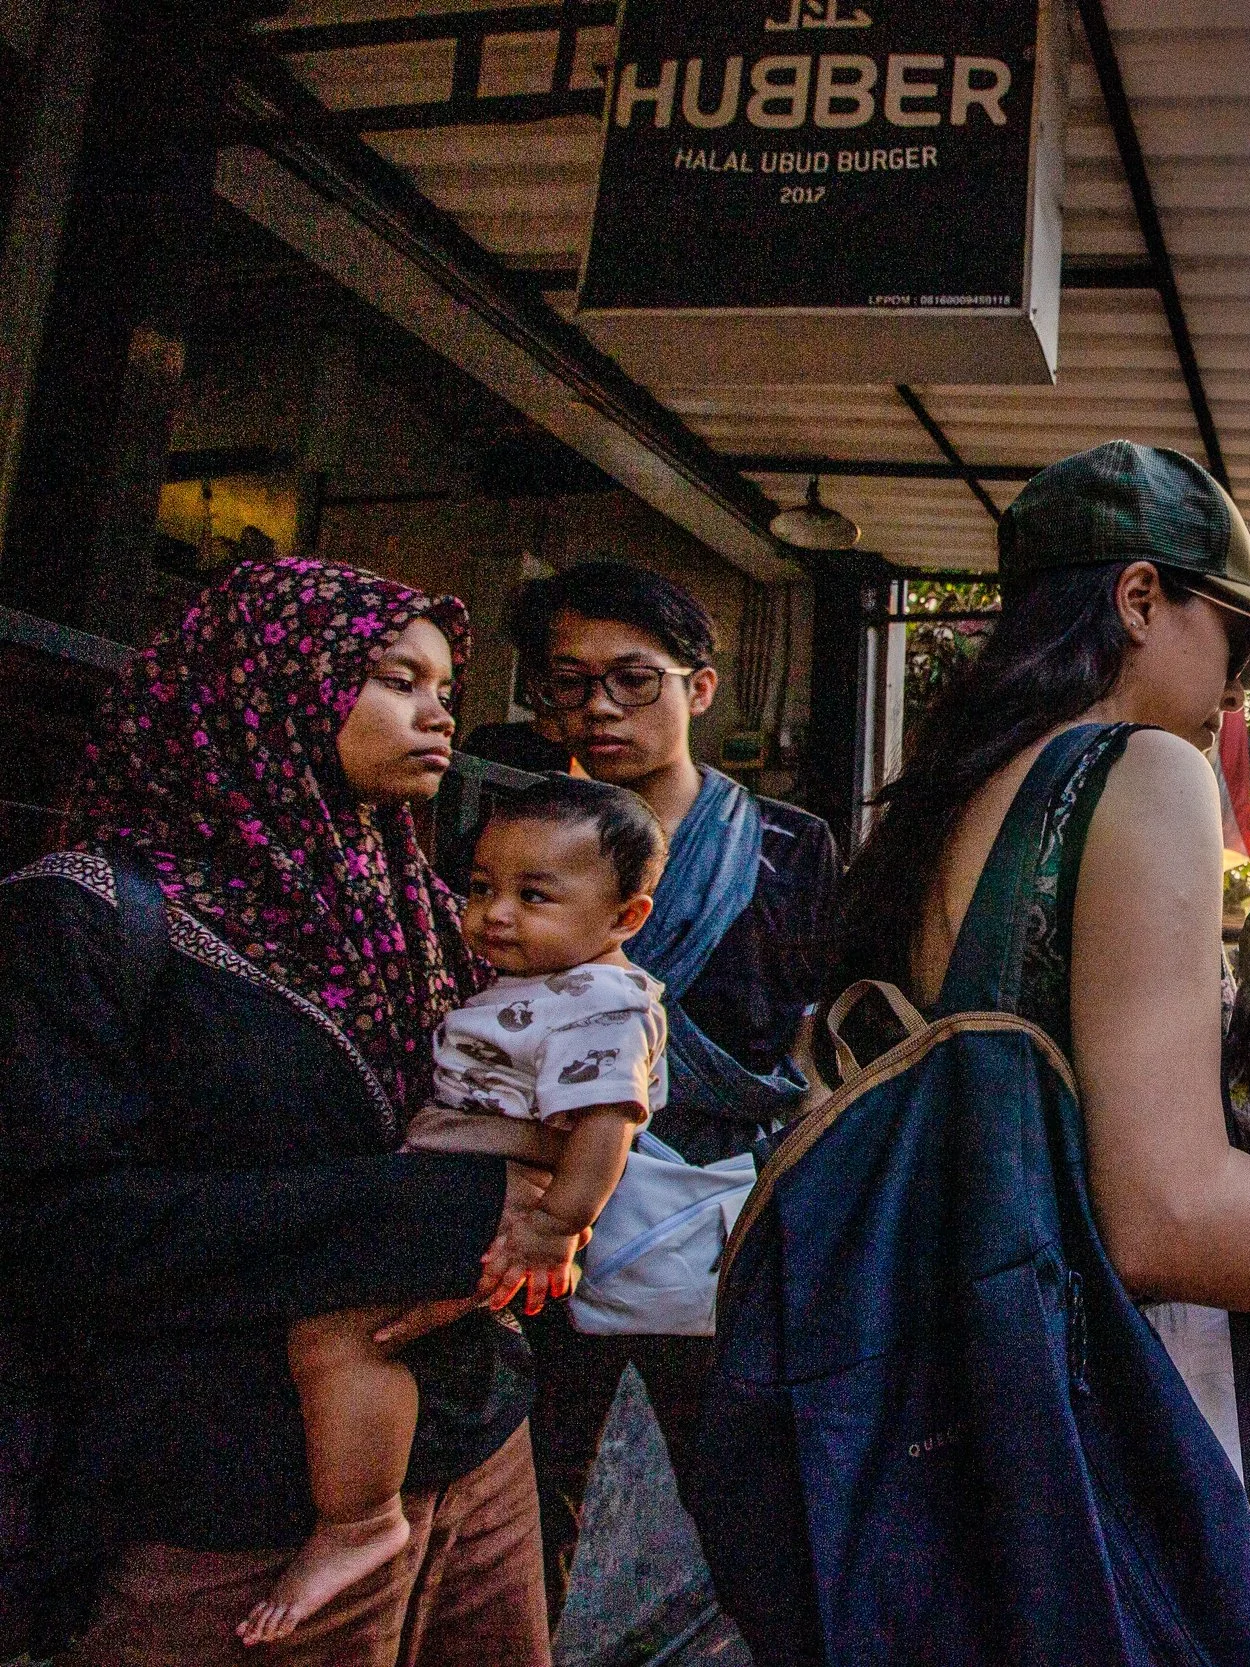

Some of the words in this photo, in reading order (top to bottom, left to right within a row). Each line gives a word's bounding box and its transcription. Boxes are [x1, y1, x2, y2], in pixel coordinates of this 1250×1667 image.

[615, 54, 1014, 129] HUBBER
[675, 148, 754, 173] HALAL
[761, 152, 830, 174] UBUD
[837, 147, 938, 172] BURGER
[780, 186, 826, 204] 2017
